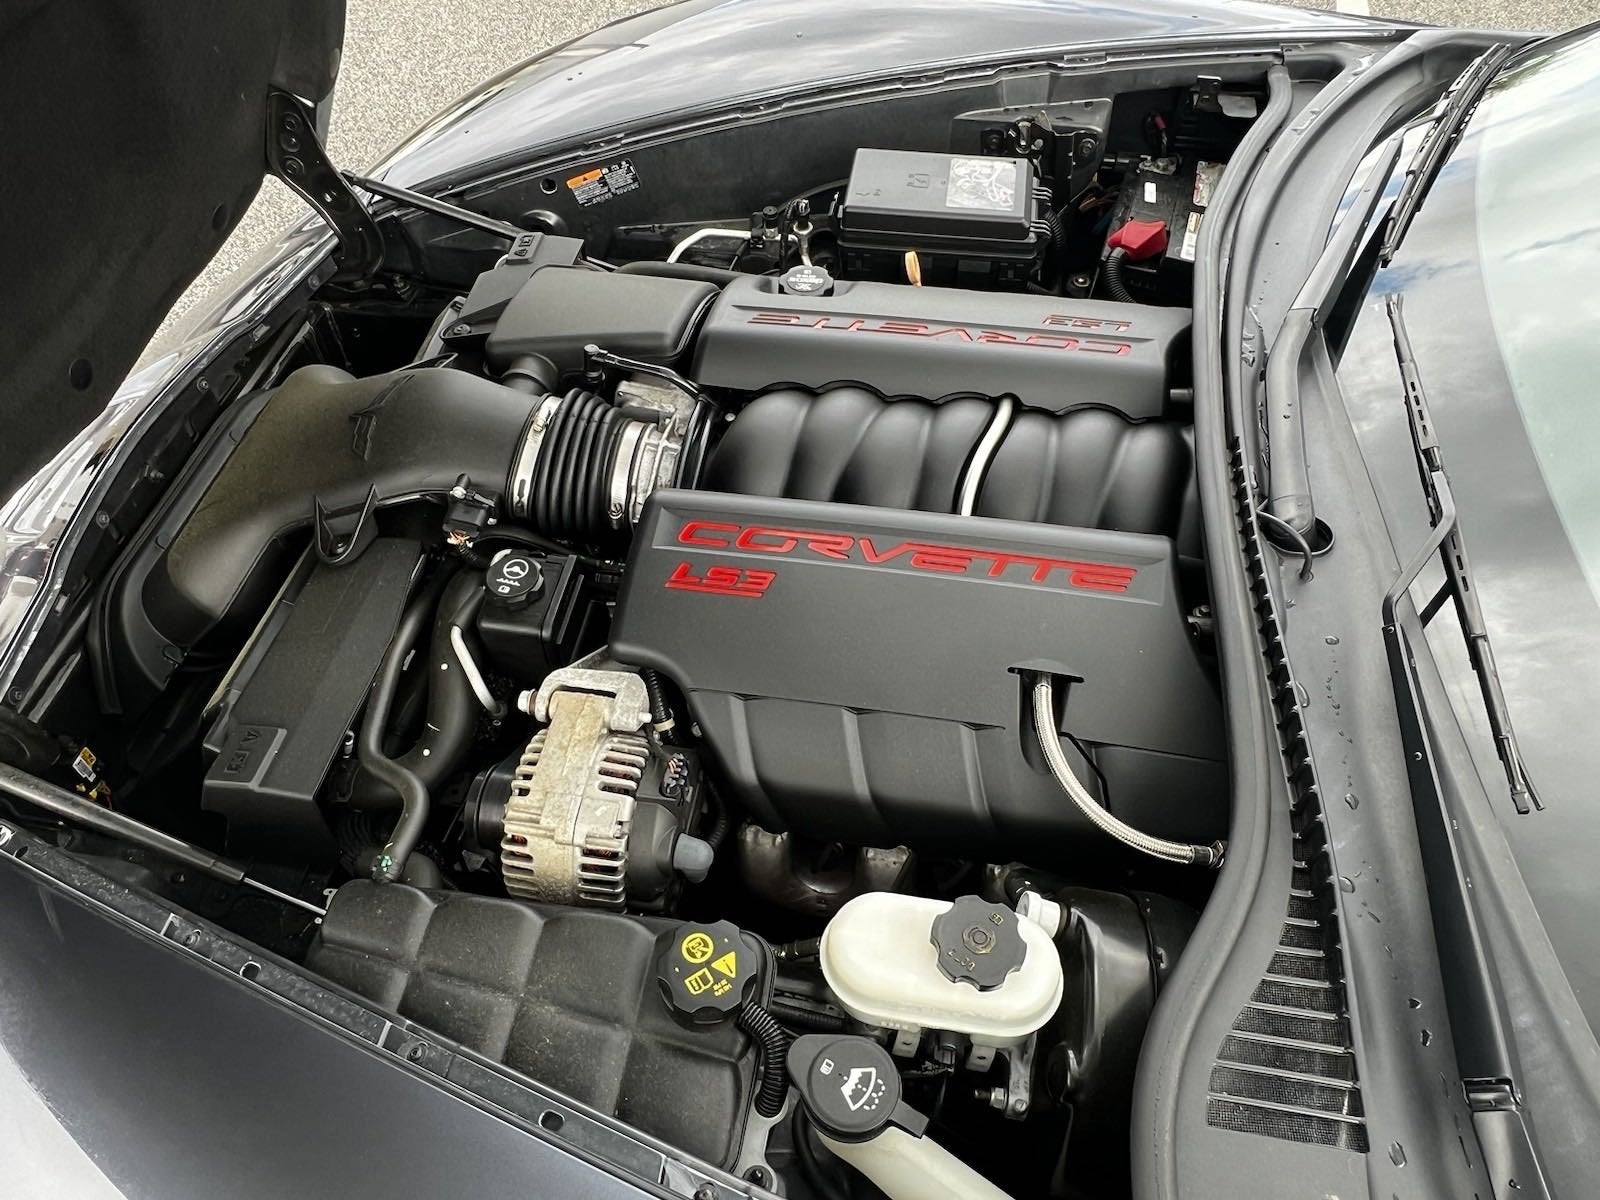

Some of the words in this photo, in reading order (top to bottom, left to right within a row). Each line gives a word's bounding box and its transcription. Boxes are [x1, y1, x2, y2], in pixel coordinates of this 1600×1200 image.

[746, 312, 1132, 356] CORVETTE
[1042, 314, 1133, 331] LS3
[678, 521, 1138, 593] CORVETTE
[664, 561, 777, 598] LS3
